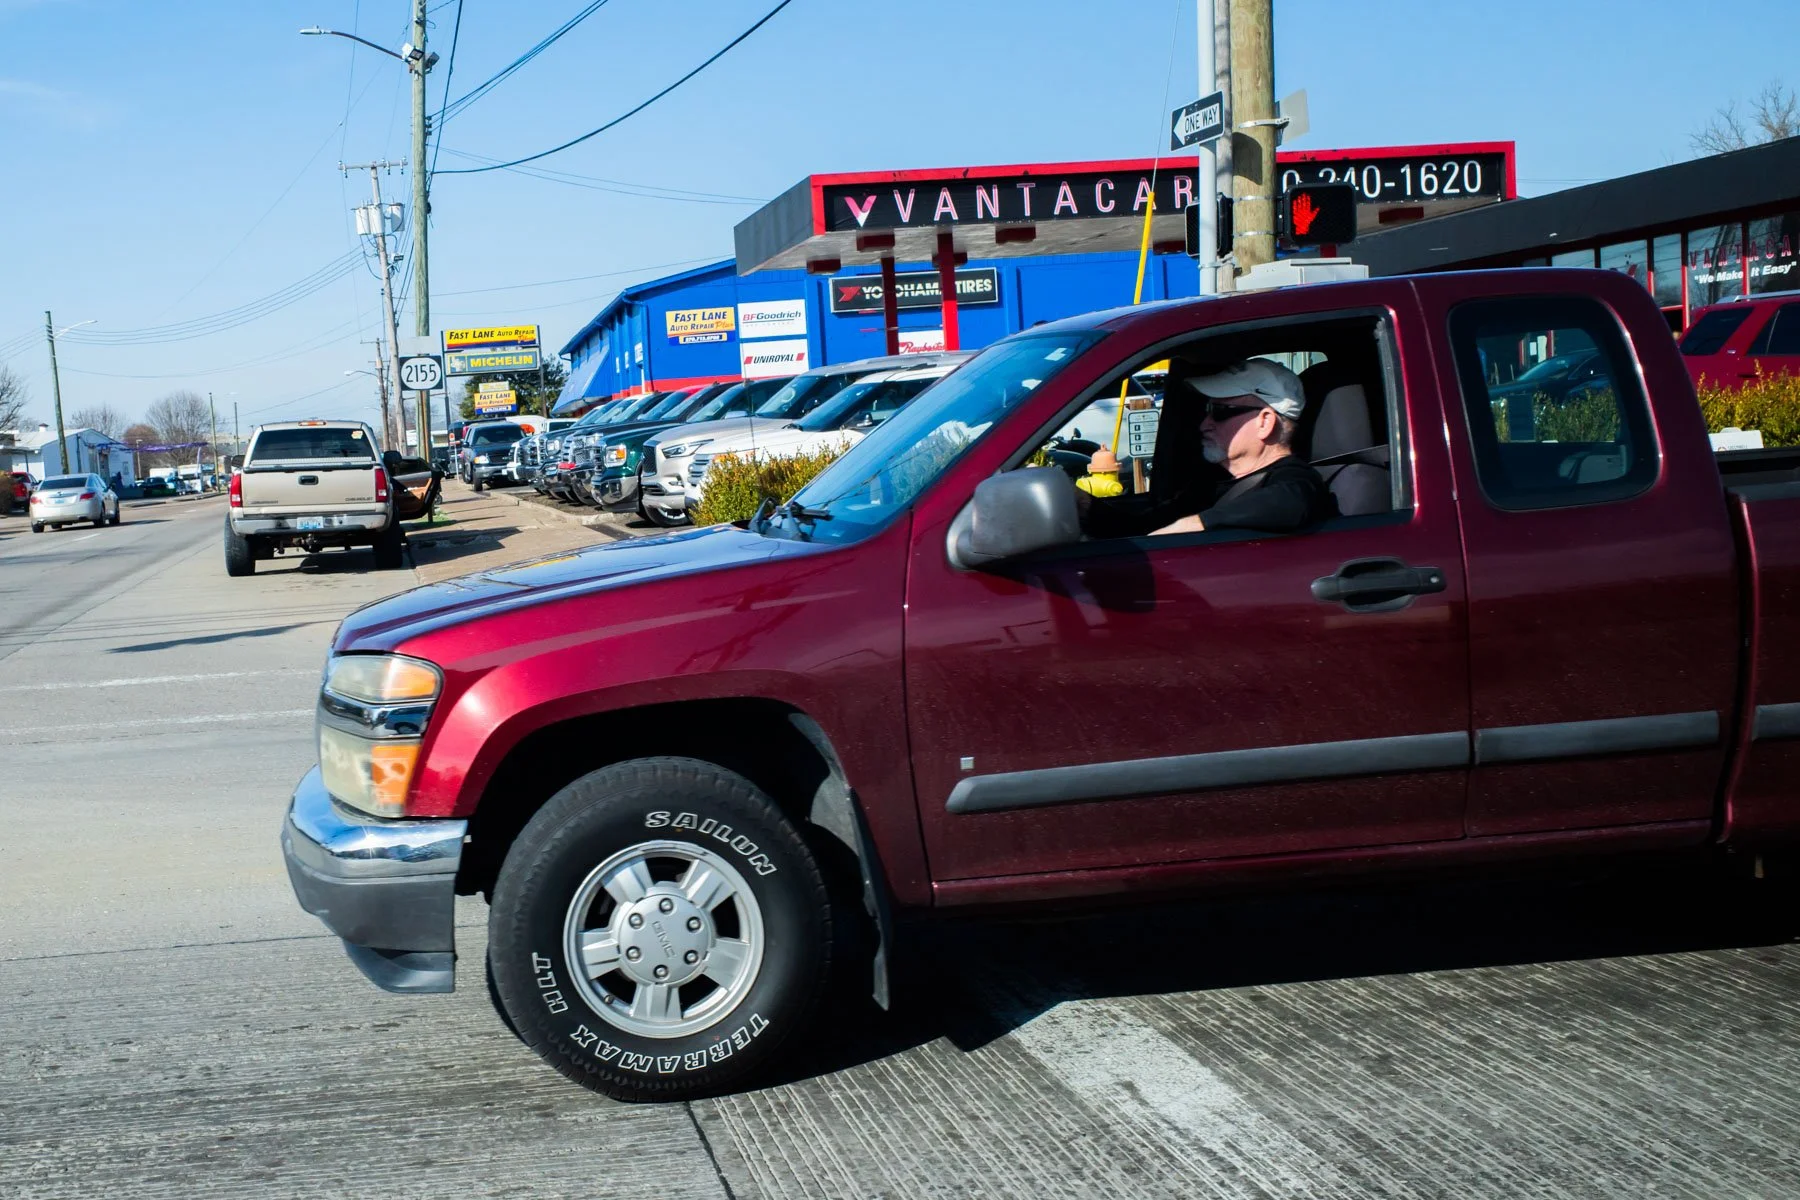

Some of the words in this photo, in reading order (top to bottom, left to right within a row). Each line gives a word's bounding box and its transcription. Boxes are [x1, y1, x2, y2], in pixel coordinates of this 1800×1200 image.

[1184, 113, 1200, 133] ONE
[1201, 105, 1218, 128] WAY
[1690, 234, 1800, 271] VANTACA
[1716, 270, 1744, 281] Make
[1750, 267, 1761, 277] It
[1762, 261, 1797, 276] Easy"
[862, 282, 942, 300] YOOHAM
[955, 279, 993, 294] TIRES
[674, 312, 698, 323] FAST
[702, 311, 727, 321] LANE
[742, 310, 801, 321] BFGoodrich
[449, 331, 470, 340] FAST
[472, 330, 495, 339] LANE
[690, 322, 715, 331] REPAIR
[470, 355, 533, 368] MICHELIN
[753, 353, 794, 365] UNIROYAL
[405, 363, 437, 383] 2155
[644, 810, 778, 876] SAILUN
[651, 920, 677, 958] GMC
[570, 1013, 769, 1073] TERRAMAX
